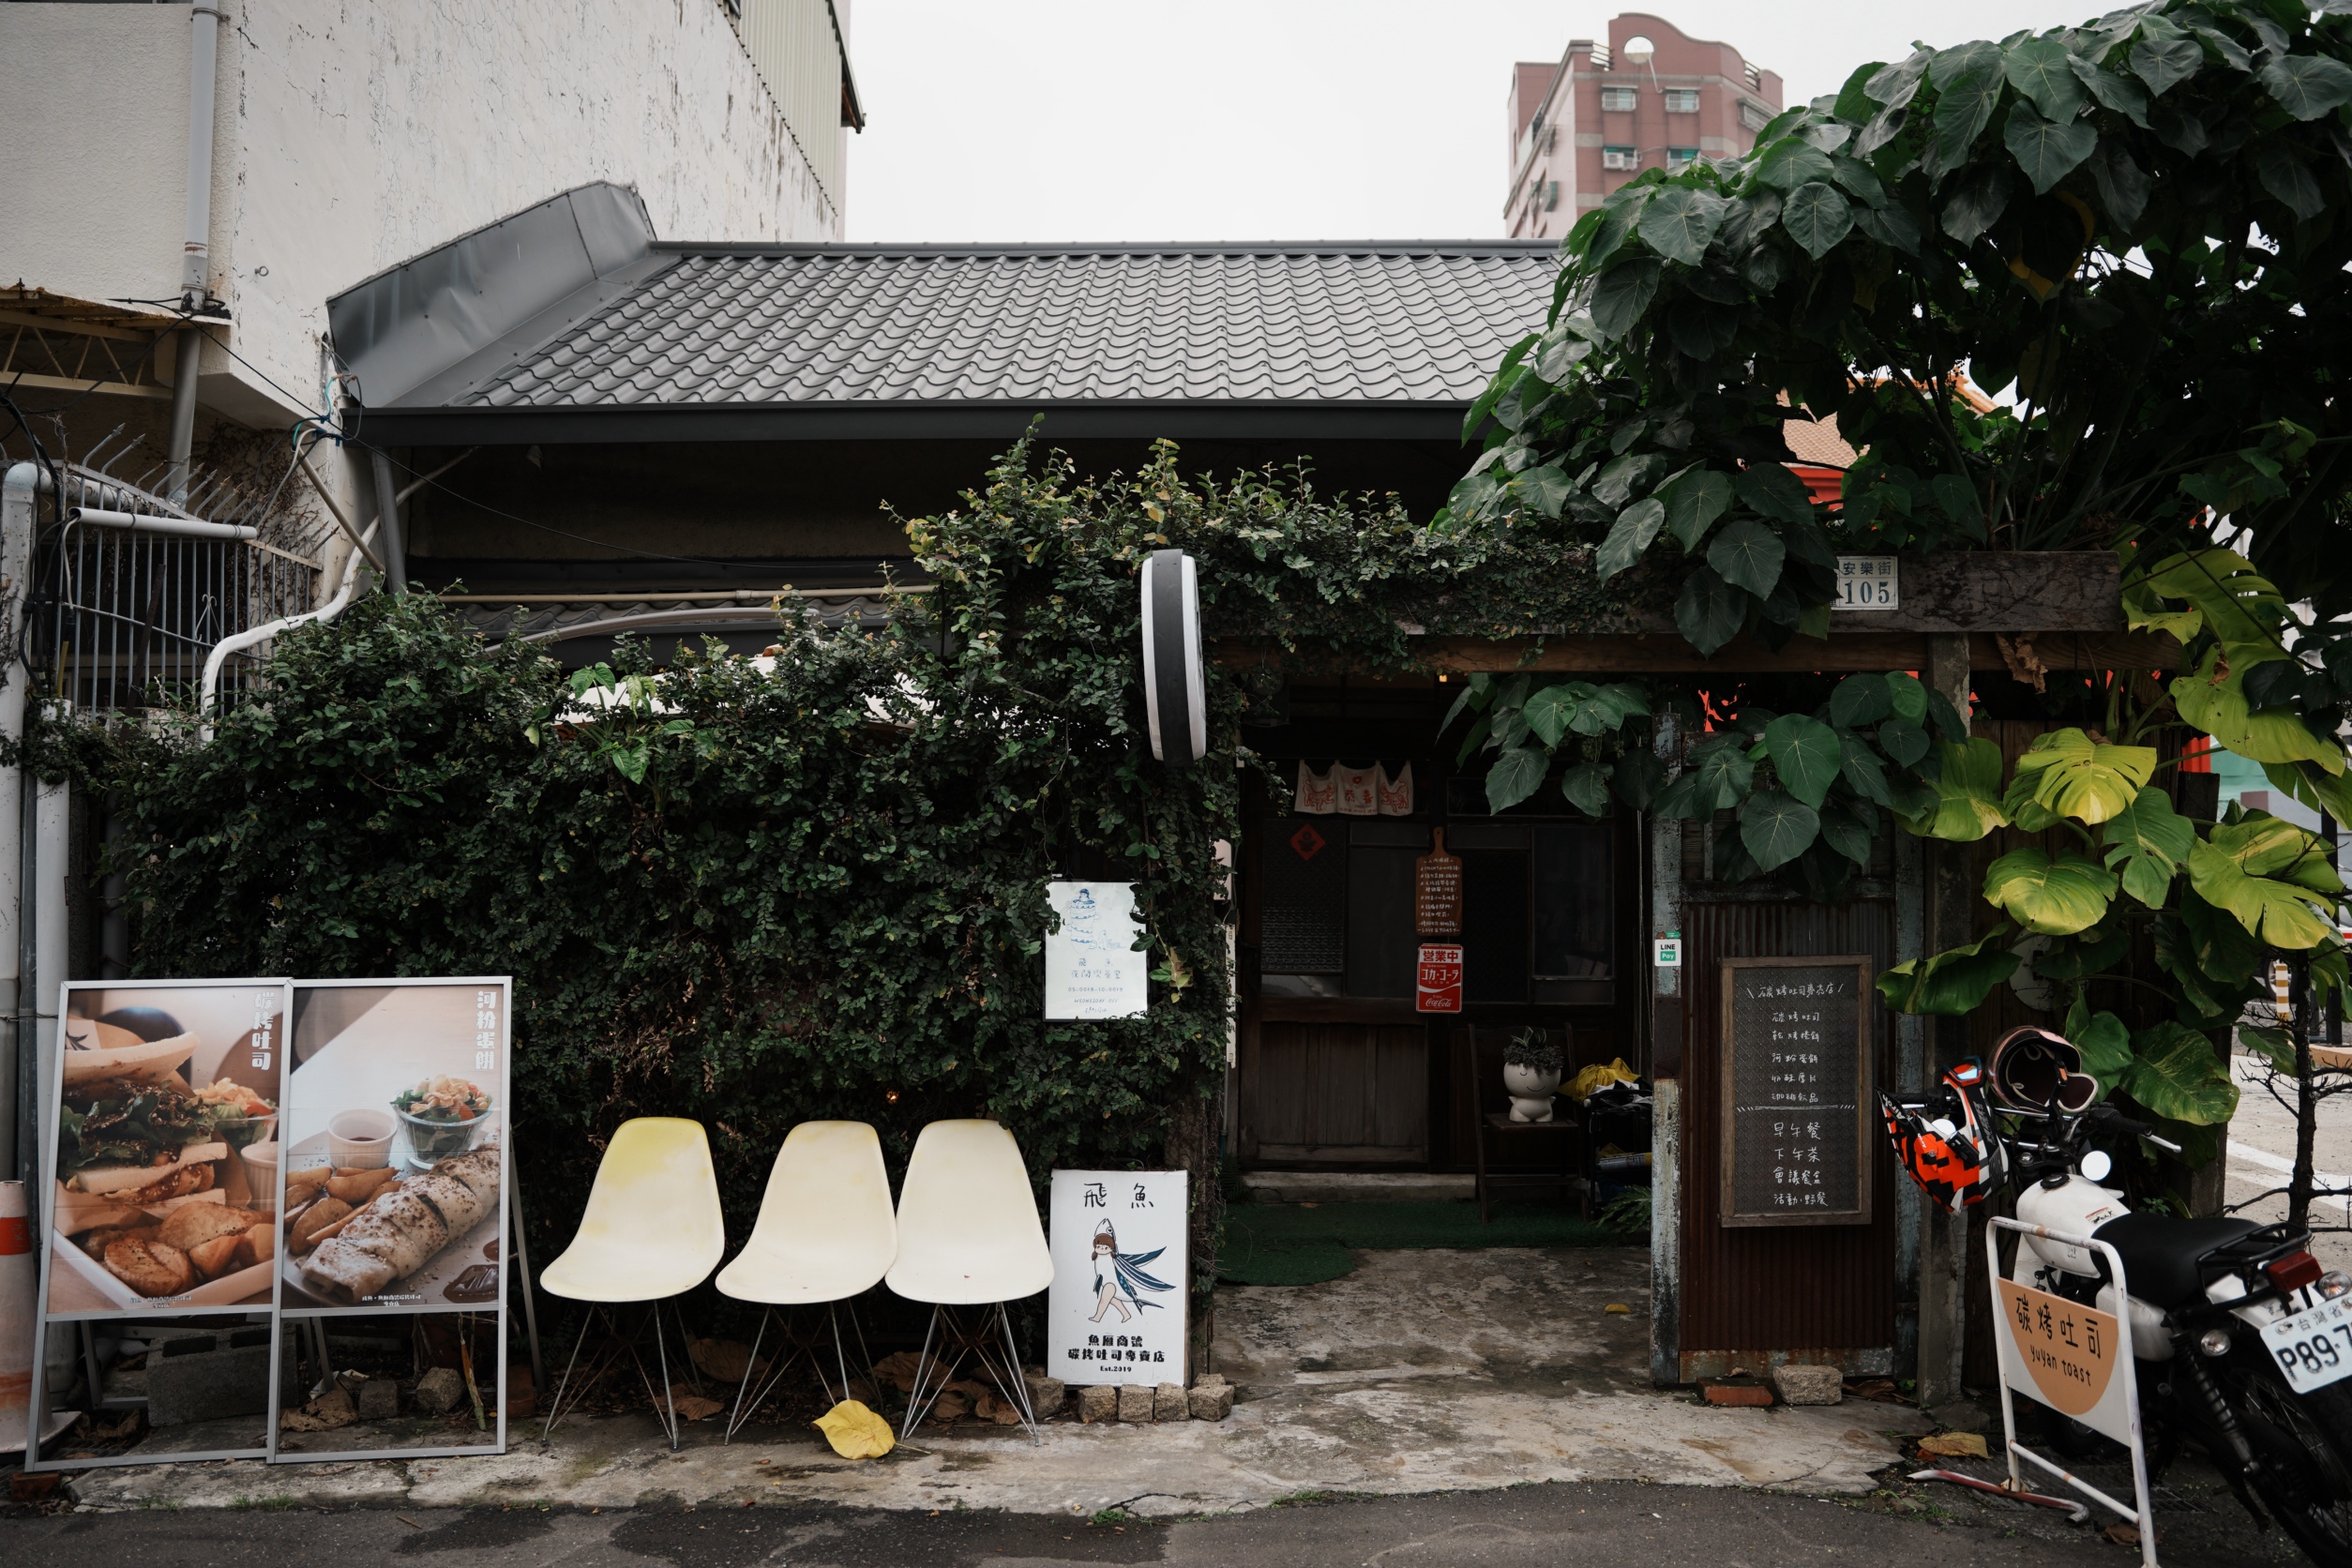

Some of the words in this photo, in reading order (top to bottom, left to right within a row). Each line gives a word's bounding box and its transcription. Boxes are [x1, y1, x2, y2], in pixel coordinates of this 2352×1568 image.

[1843, 561, 1892, 576] 安樂街
[1844, 580, 1890, 604] 105
[1345, 789, 1374, 805] 恭喜
[1423, 950, 1458, 962] 営業中
[251, 991, 275, 1071] 碳烤吐司
[475, 990, 497, 1070] 河粉蛋餅
[1773, 1122, 1821, 1140] 早午餐
[1773, 1146, 1821, 1163] 下午茶
[1083, 1183, 1154, 1209] 飛魚
[2015, 1293, 2102, 1360] 碳烤吐司
[2029, 1344, 2058, 1370] yuyan
[2061, 1359, 2091, 1387] toast
